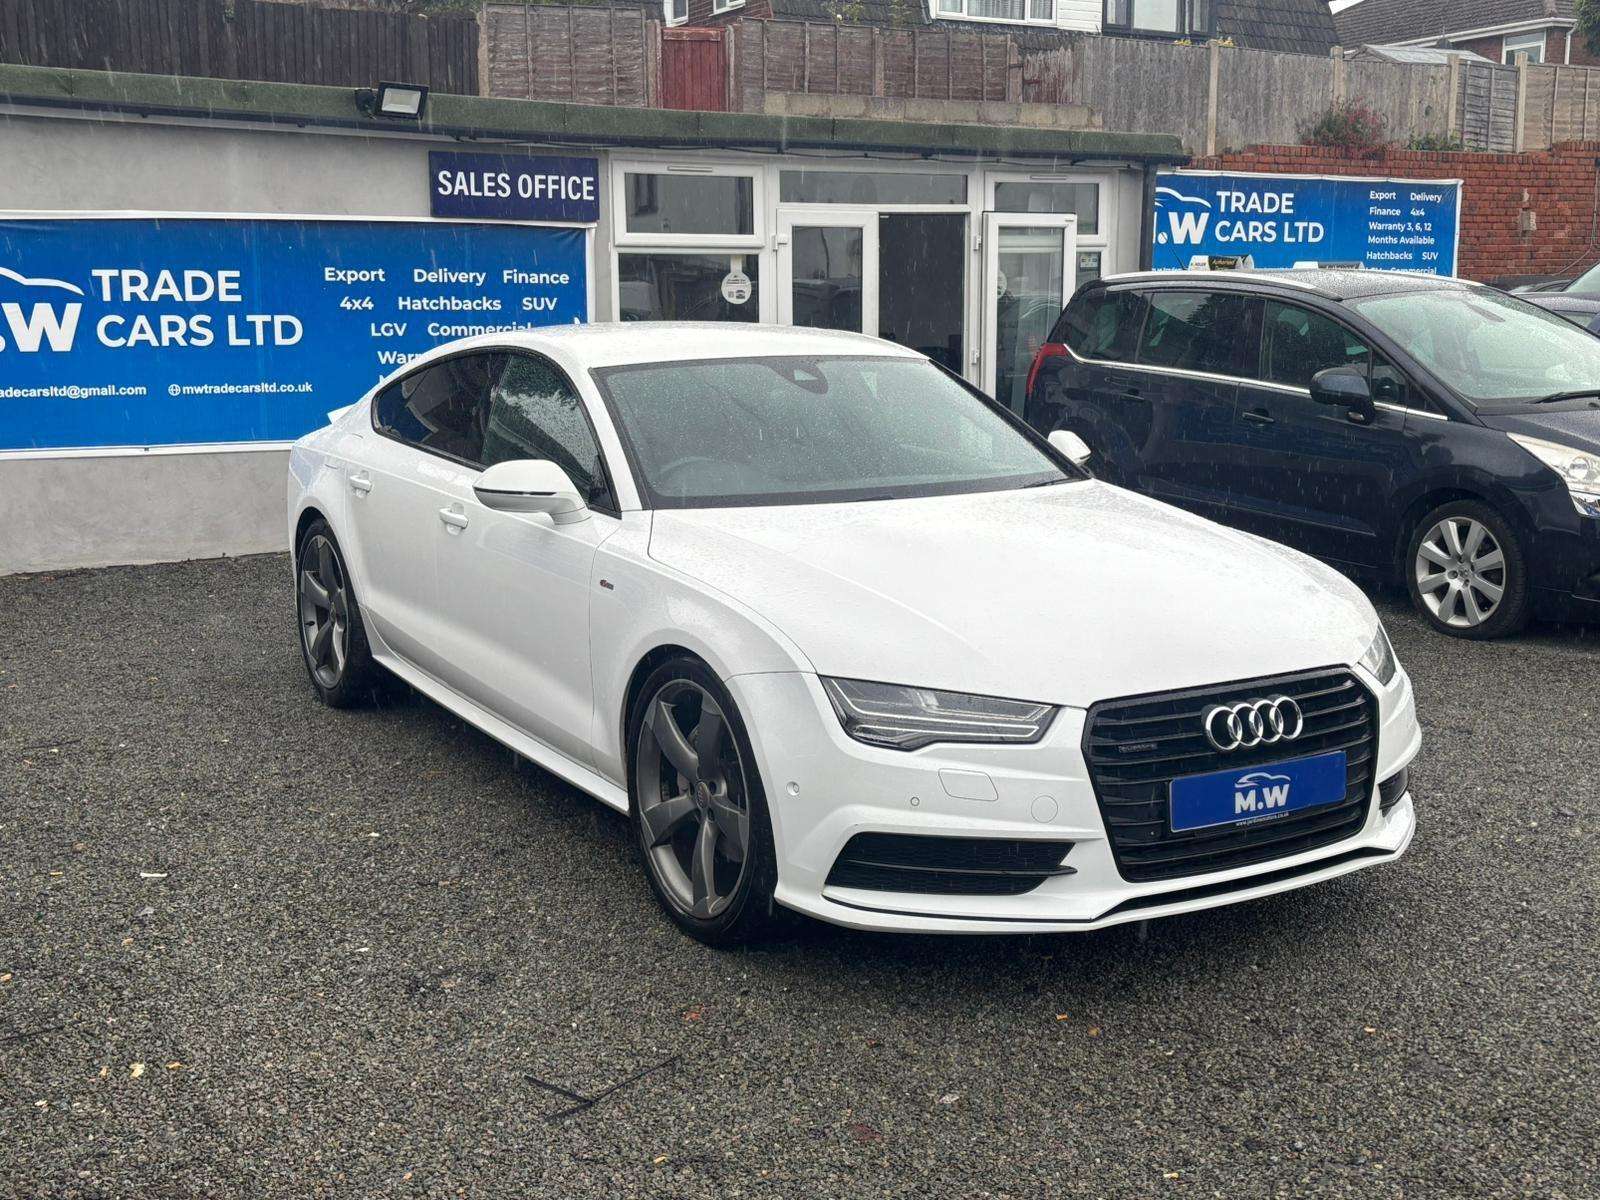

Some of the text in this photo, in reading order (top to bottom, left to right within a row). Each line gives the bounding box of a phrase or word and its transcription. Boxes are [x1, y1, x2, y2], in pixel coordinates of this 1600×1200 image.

[437, 171, 595, 201] SALES OFFICE
[1217, 191, 1294, 214] TRADE
[1369, 190, 1442, 203] Export Delivery
[1369, 206, 1425, 216] Finance 4x4
[1215, 220, 1324, 243] CARS LTD
[1369, 221, 1405, 232] Warranty
[1406, 222, 1414, 232] 3,
[1424, 222, 1432, 231] 12
[1368, 235, 1435, 245] Months Available
[1366, 251, 1439, 260] Hatchbacks SUV
[324, 267, 570, 287] Export Delivery Finance
[92, 269, 242, 303] TRADE
[340, 296, 558, 311] 4x4 Hatchbacks SUV
[96, 314, 303, 348] CARS LTD
[371, 322, 407, 337] LGV
[182, 382, 313, 395] mwtradecarsltd.co.uk
[1234, 783, 1290, 814] M.W
